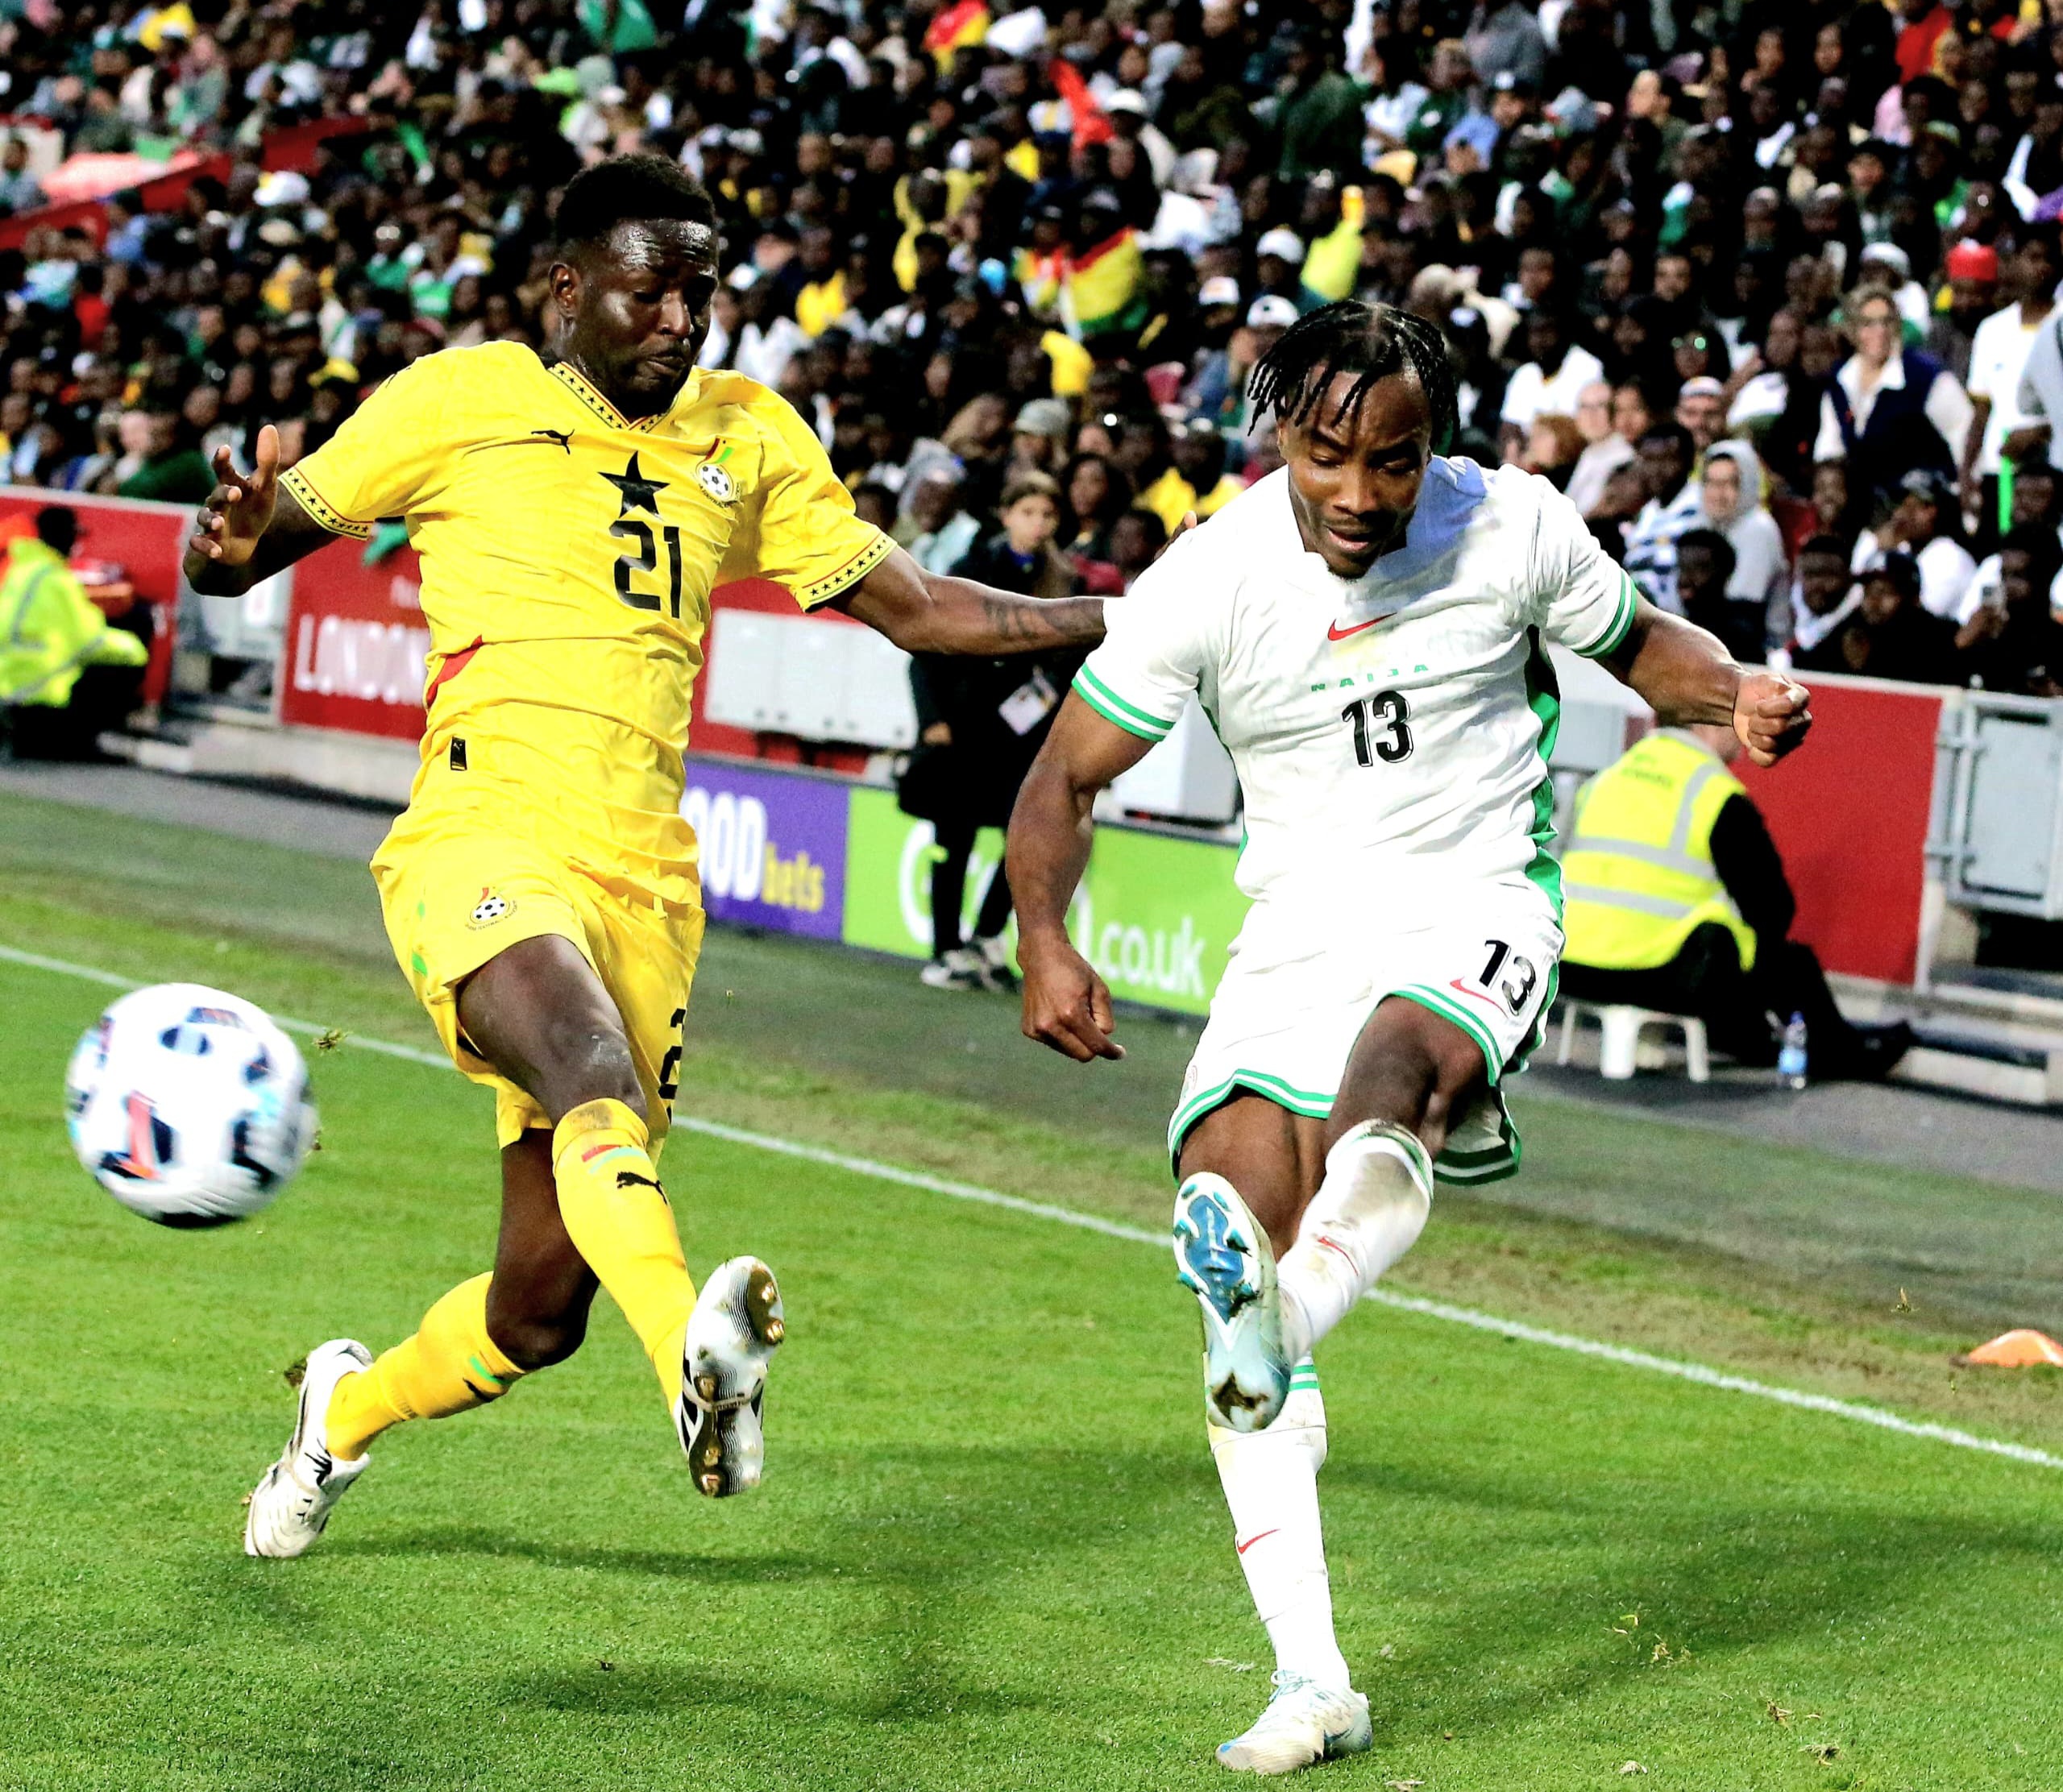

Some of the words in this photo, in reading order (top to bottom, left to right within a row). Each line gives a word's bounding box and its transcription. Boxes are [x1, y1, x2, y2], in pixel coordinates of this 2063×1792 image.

[608, 520, 683, 619] 21
[1311, 664, 1429, 692] NAIJA
[1341, 690, 1414, 767] 13
[1479, 940, 1537, 1017] 13
